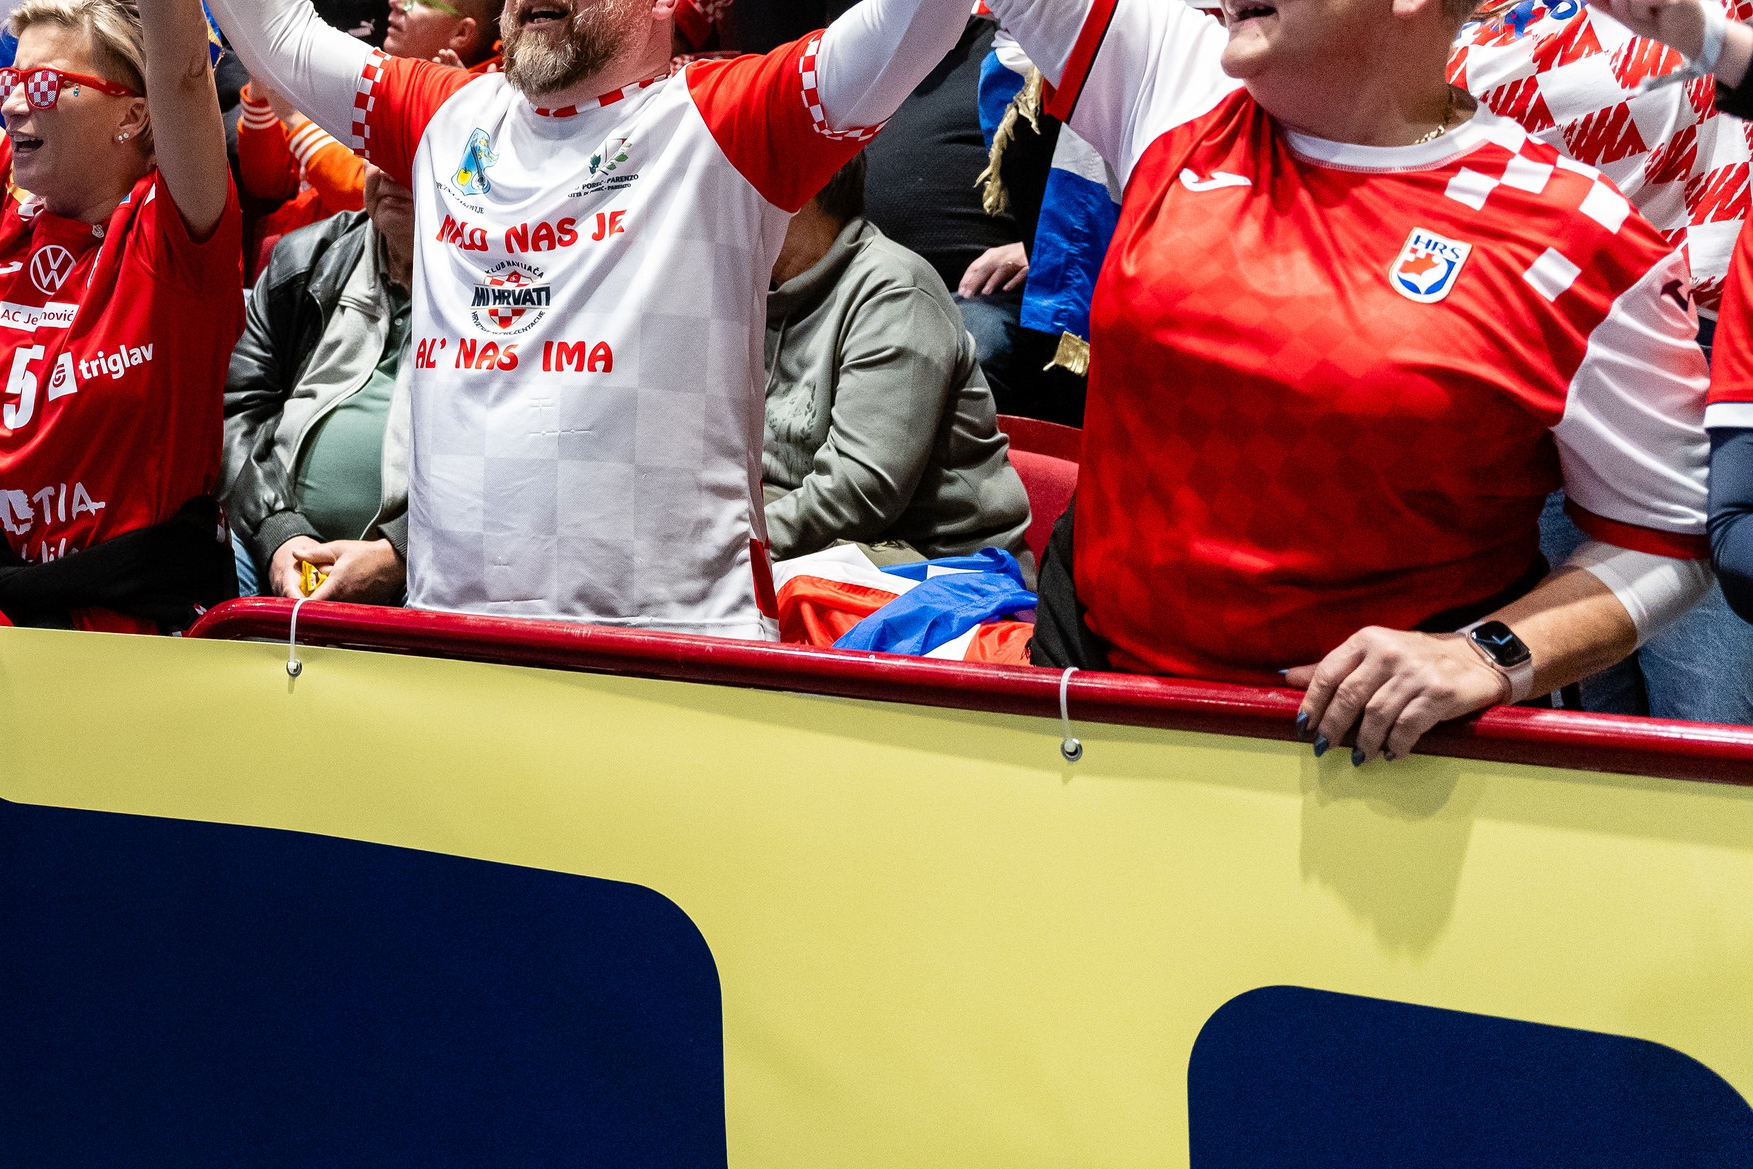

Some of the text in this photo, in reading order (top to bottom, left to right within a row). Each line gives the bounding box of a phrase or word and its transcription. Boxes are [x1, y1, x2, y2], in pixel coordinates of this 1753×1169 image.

[436, 209, 628, 254] MALO NAS JE
[1413, 234, 1463, 260] HRS
[485, 260, 506, 275] KLUB
[471, 286, 551, 307] MI HRVATI
[0, 308, 21, 323] AC
[78, 343, 154, 380] triglav
[415, 337, 614, 374] AL' NAS IMA
[3, 344, 45, 430] 5
